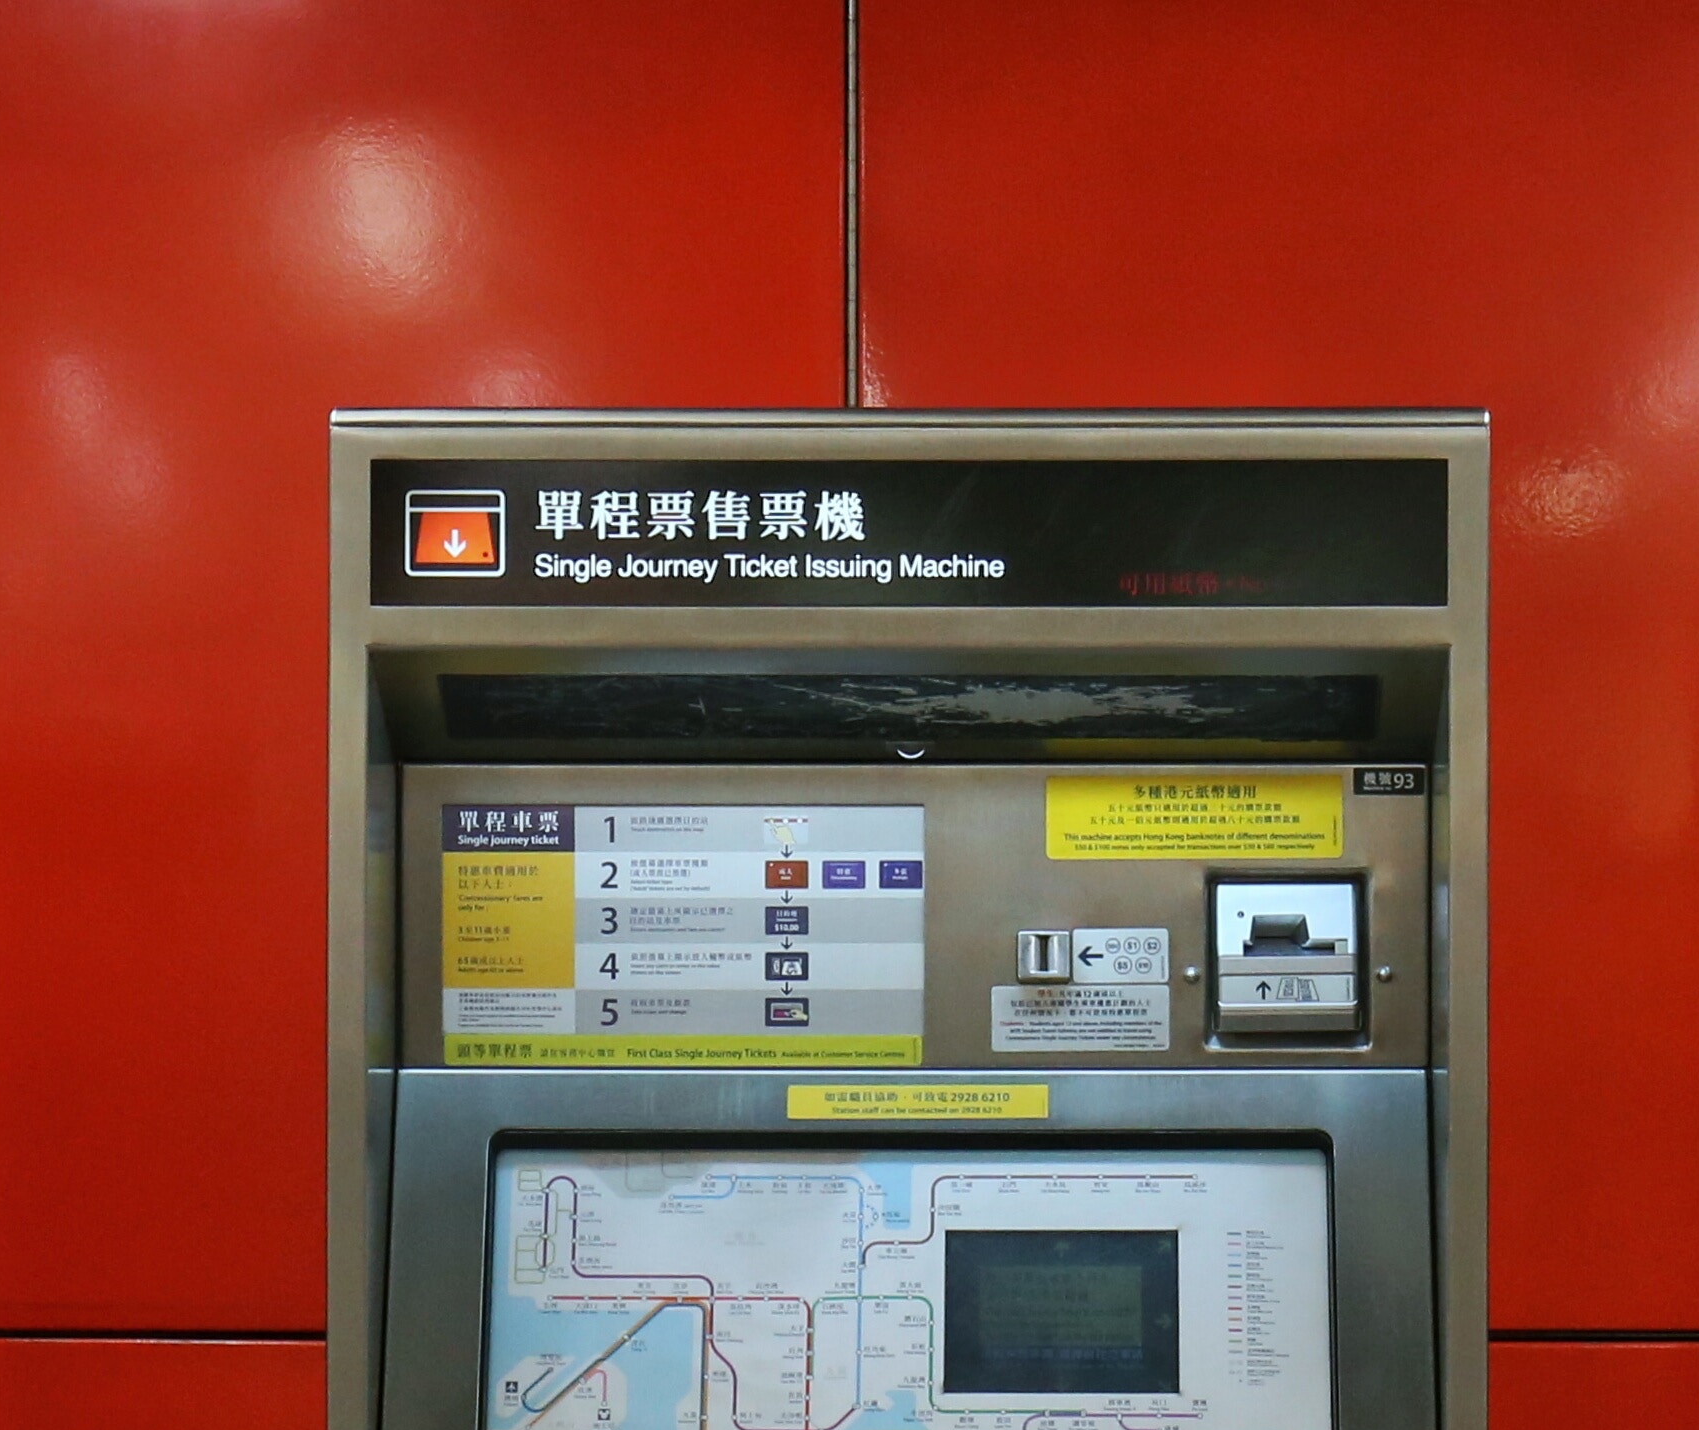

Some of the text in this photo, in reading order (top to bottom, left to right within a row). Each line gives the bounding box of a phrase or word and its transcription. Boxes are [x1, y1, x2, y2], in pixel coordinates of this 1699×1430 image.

[534, 489, 867, 541] 單程票售票機
[534, 552, 1006, 582] Single Journey Ticket Issuing Machine
[1134, 784, 1258, 800] 多種港元紙幣適用
[1393, 773, 1416, 789] 93
[459, 810, 616, 843] 單程車票 1
[457, 834, 560, 847] Single journey ticket
[1064, 833, 1326, 843] This machine accepts Hong Kong banknotes of different denominations
[600, 861, 619, 889] 2
[600, 906, 619, 935] 3
[599, 952, 620, 980] 4
[600, 998, 619, 1026] 5
[457, 1043, 533, 1059] 頭等單程票
[626, 1047, 648, 1059] First
[649, 1047, 674, 1059] Class
[674, 1047, 704, 1060] Single
[705, 1047, 744, 1060] Journey
[744, 1047, 778, 1059] Tickets
[820, 1050, 853, 1059] Customer
[854, 1050, 878, 1059] Service
[878, 1050, 906, 1059] Centres
[950, 1092, 1011, 1103] 2928 6210
[832, 1106, 860, 1114] Station
[861, 1106, 879, 1114] staff
[895, 1106, 906, 1114] be
[907, 1106, 947, 1114] contacted
[961, 1106, 981, 1114] 2928
[982, 1106, 1003, 1114] 6210
